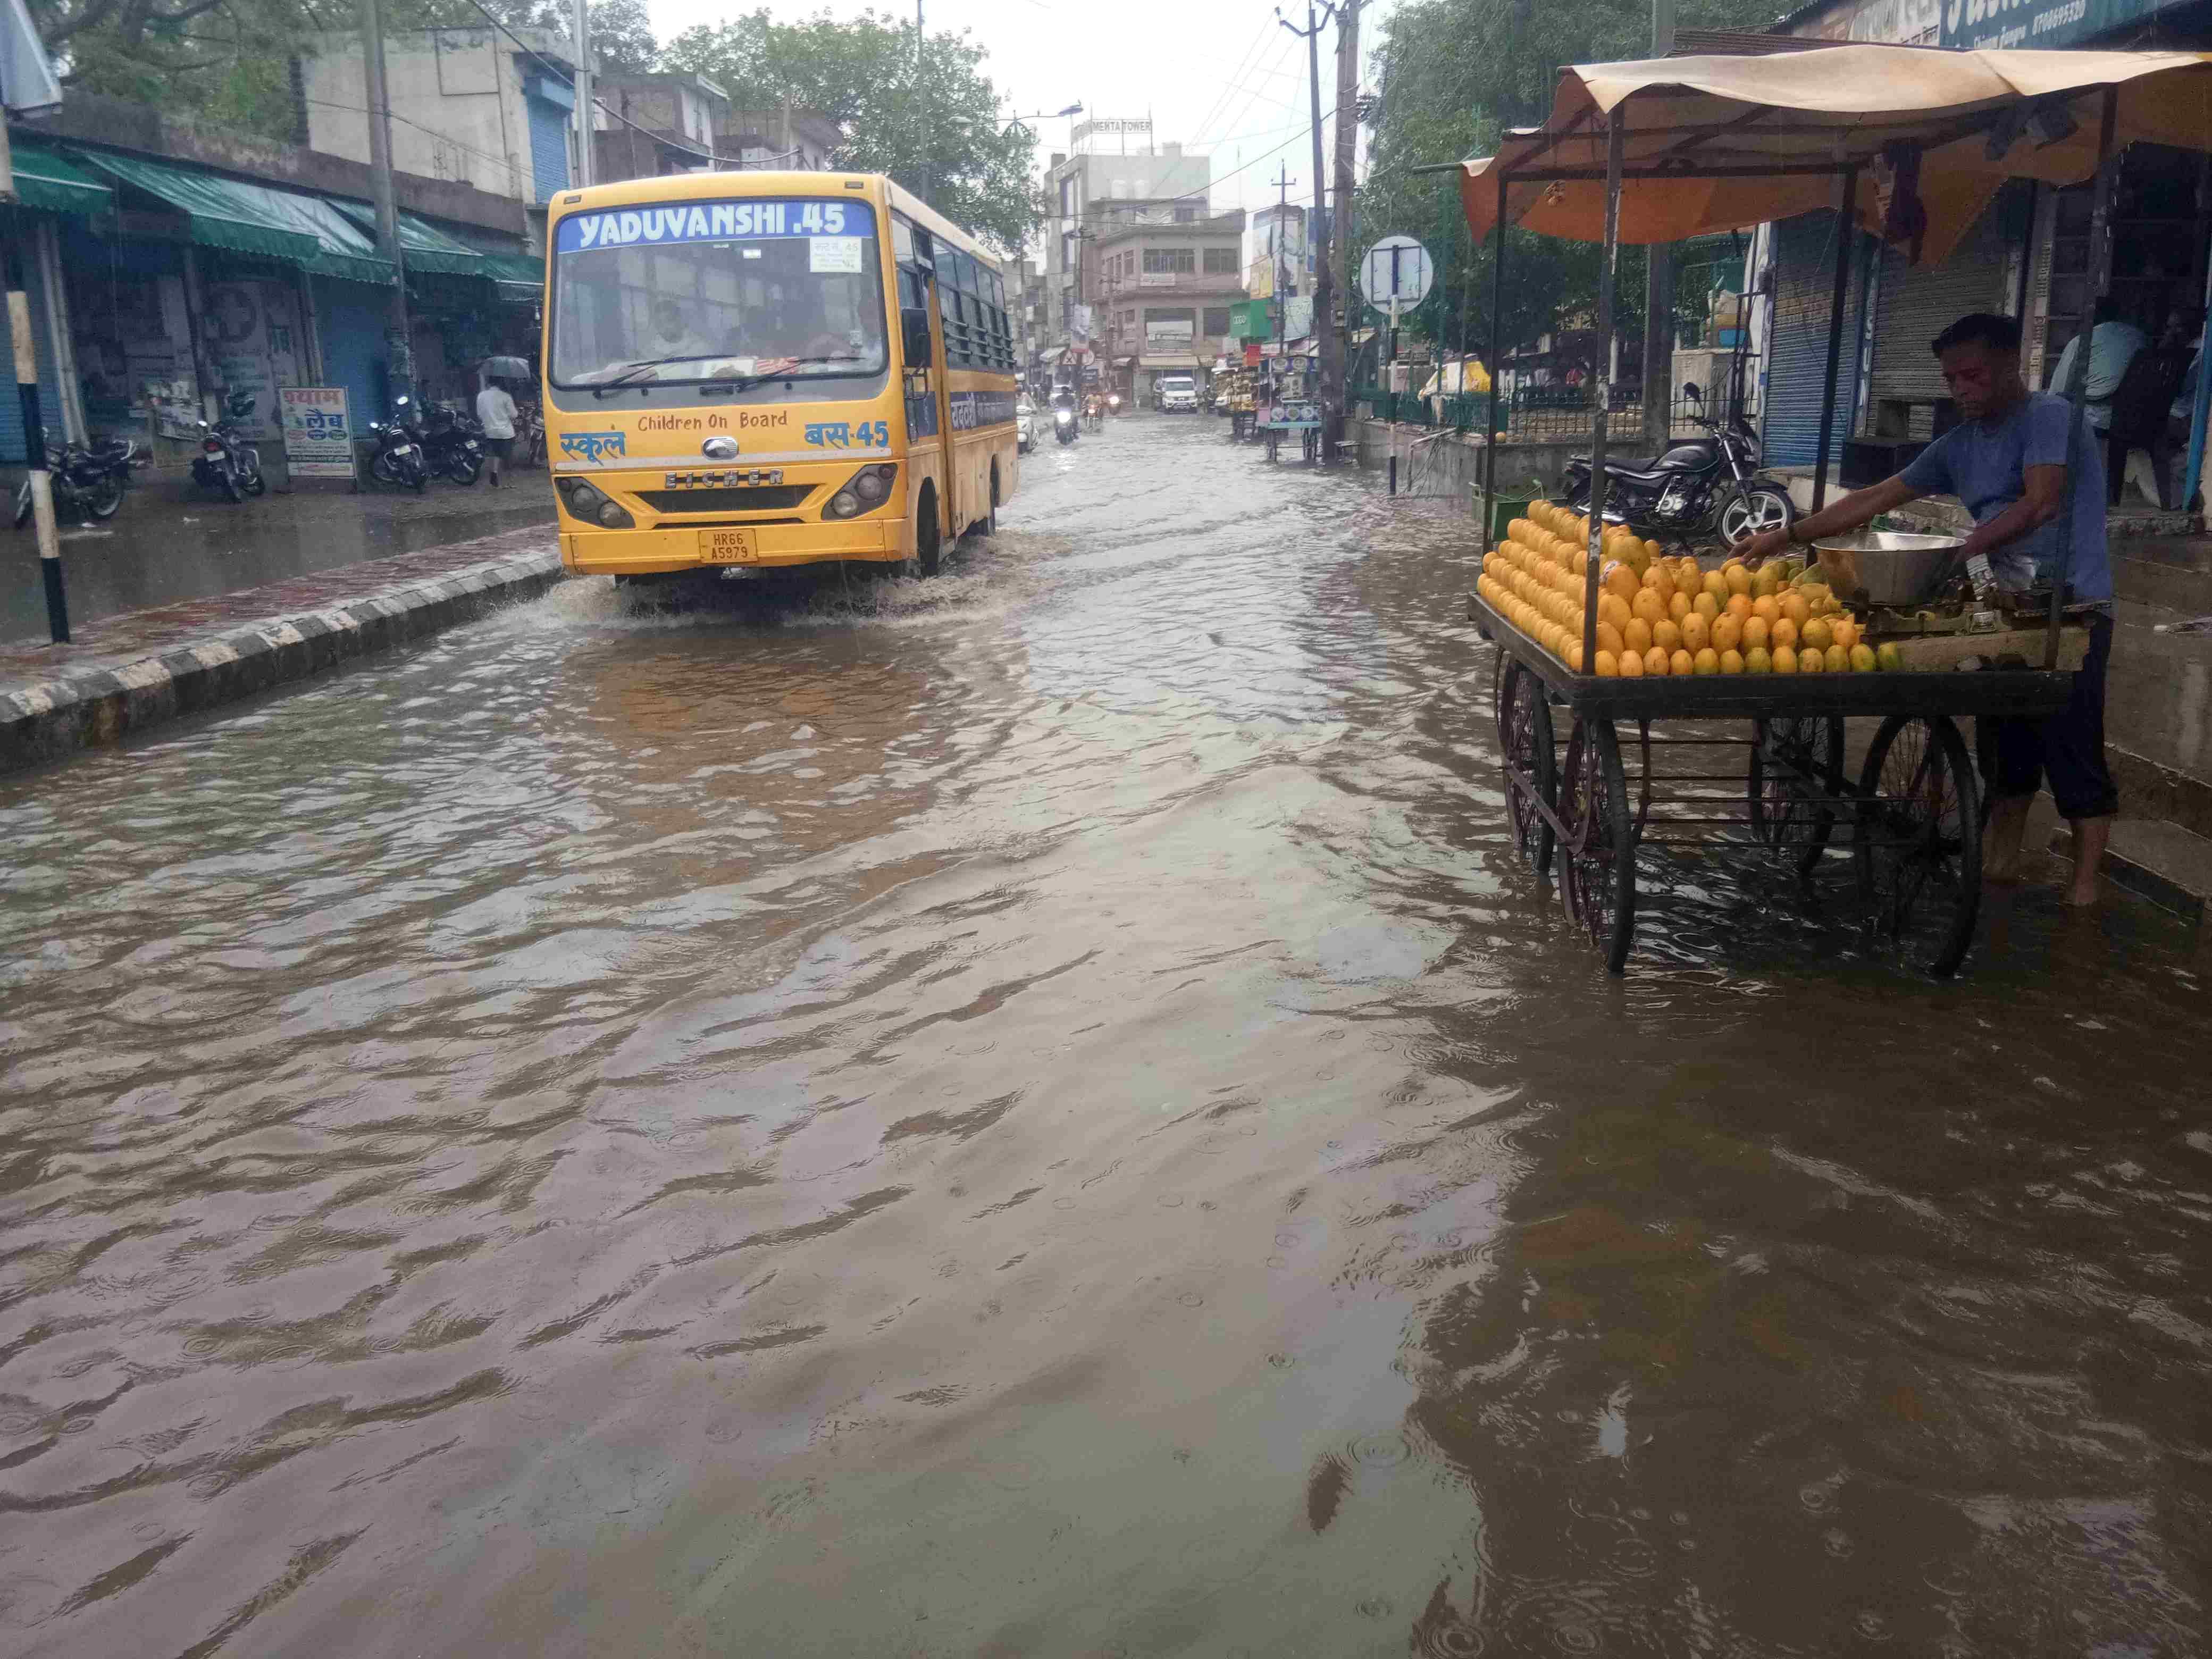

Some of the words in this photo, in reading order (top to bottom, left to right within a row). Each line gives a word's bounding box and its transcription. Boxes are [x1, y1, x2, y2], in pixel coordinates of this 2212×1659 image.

[1093, 121, 1120, 131] MEHTA
[1123, 121, 1151, 131] TOWER
[579, 204, 785, 248] YADUVANSHI
[638, 415, 702, 432] Children
[708, 414, 728, 429] On
[740, 410, 787, 429] Board
[559, 432, 626, 466] स्कूल
[665, 468, 784, 489] EICHER
[714, 533, 743, 546] HR66
[712, 546, 748, 560] A5979
